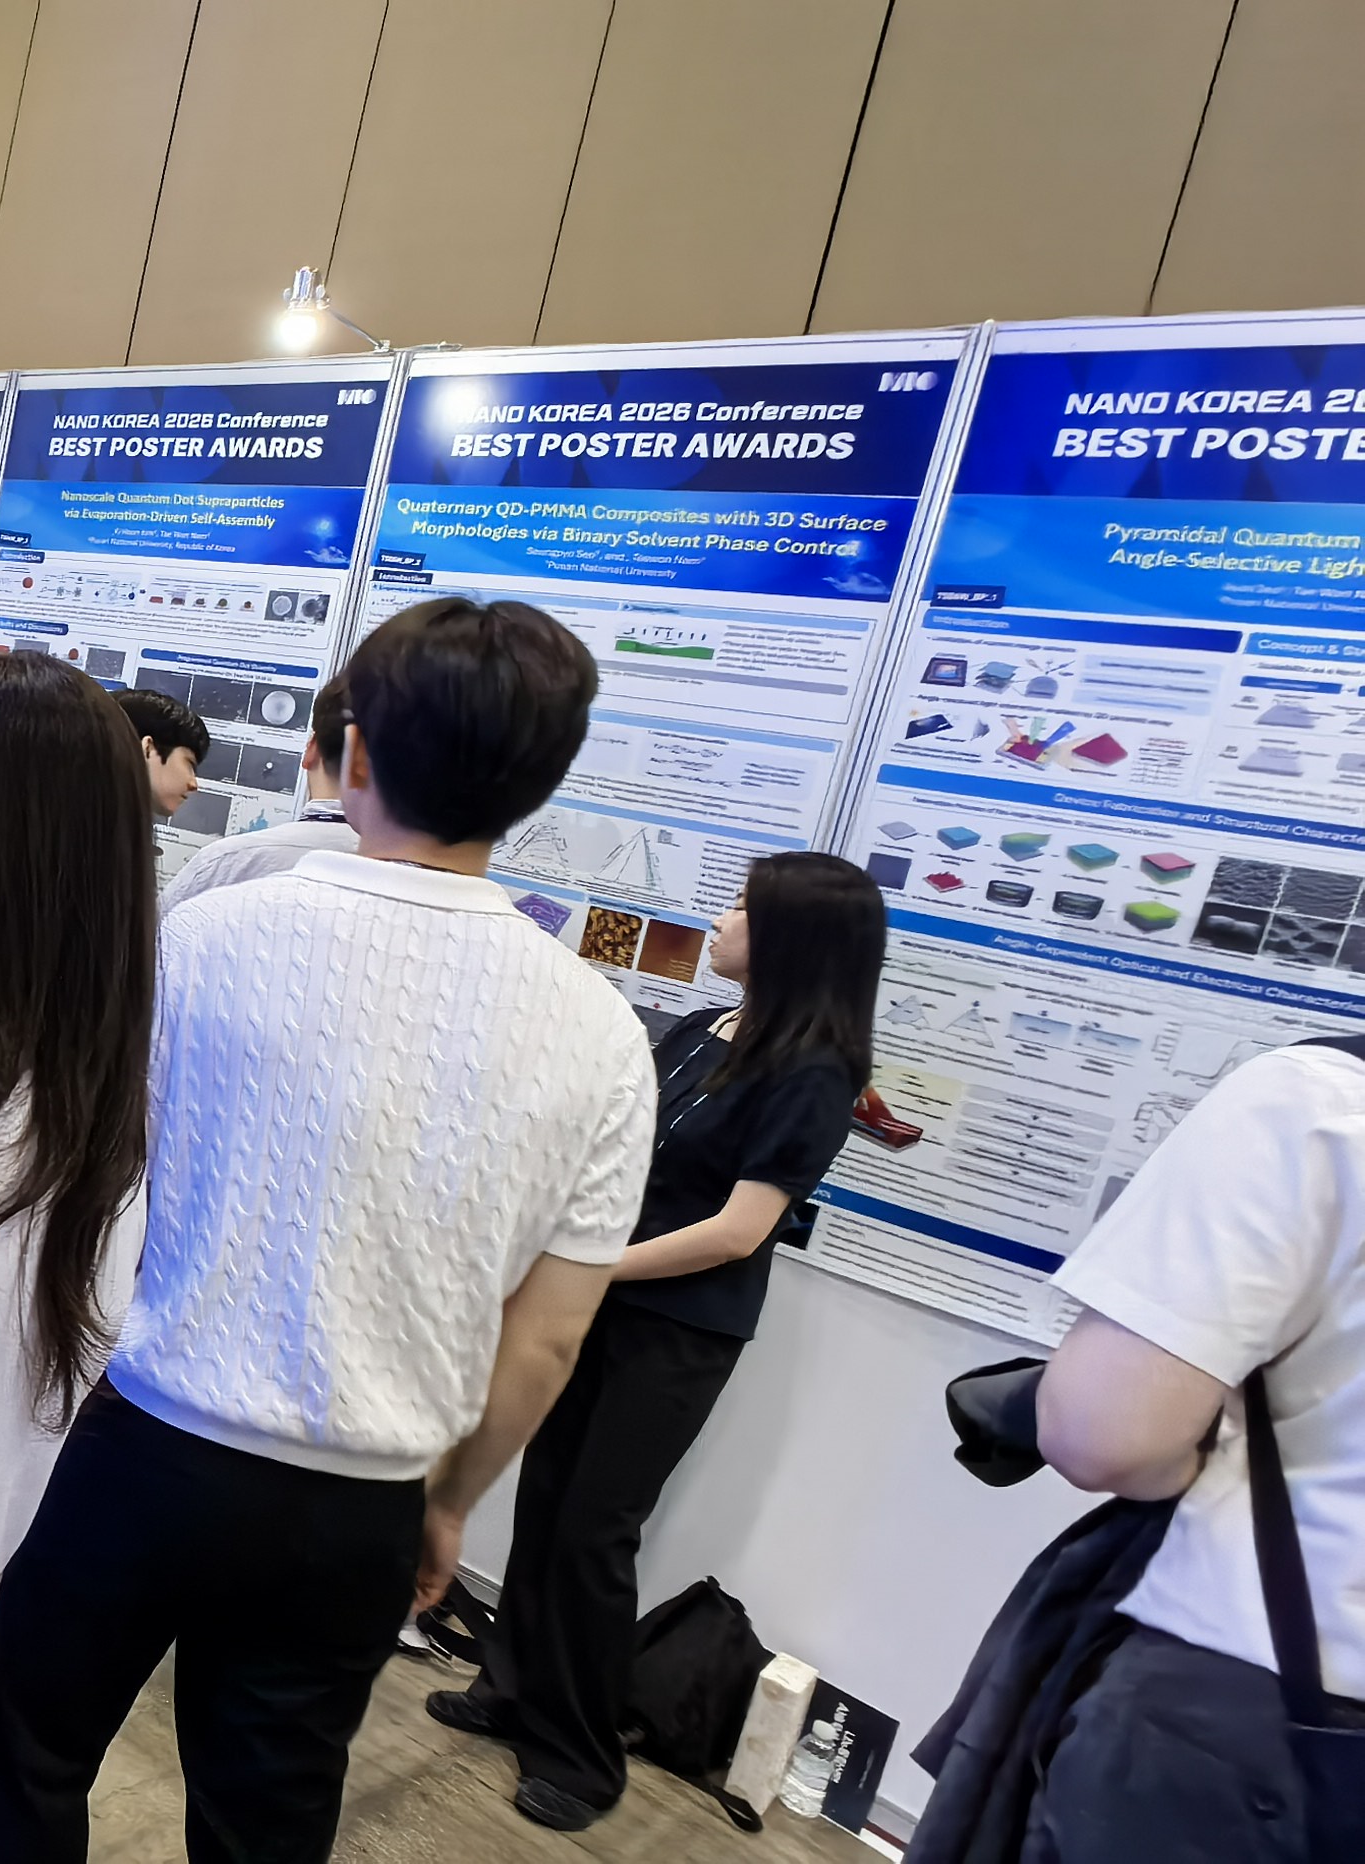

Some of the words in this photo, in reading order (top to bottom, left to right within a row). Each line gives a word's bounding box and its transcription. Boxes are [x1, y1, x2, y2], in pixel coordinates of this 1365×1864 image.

[527, 402, 612, 424] KOREA
[618, 402, 691, 423] 2026
[695, 400, 864, 423] Conference
[1065, 392, 1170, 415] NANO
[1175, 390, 1312, 415] KOREA
[53, 414, 99, 429] NANO
[102, 414, 161, 429] KOREA
[164, 414, 214, 429] 2026
[217, 412, 329, 429] Conference
[48, 437, 106, 457] BEST
[109, 437, 204, 457] POSTER
[208, 436, 324, 459] AWARDS
[450, 433, 534, 458] BEST
[538, 433, 674, 459] POSTER
[681, 431, 855, 461] AWARDS
[1052, 427, 1187, 458] BEST
[61, 490, 115, 504] Nanoscale
[118, 491, 171, 507] Quantum
[173, 493, 195, 506] Dot
[197, 493, 285, 510] Supraparticles
[64, 509, 80, 519] via
[82, 509, 188, 526] Evaporation-Driven
[190, 512, 276, 530] Self-Assembly
[397, 497, 491, 521] Quaternary
[494, 500, 587, 520] QD-PMMA
[592, 503, 711, 527] Composites
[715, 507, 760, 527] with
[764, 508, 795, 528] 3D
[799, 511, 888, 533] Surface
[411, 518, 528, 543] Morphologies
[532, 525, 558, 541] via
[563, 526, 621, 549] Binary
[625, 529, 701, 550] Solvent
[705, 532, 770, 553] Phase
[773, 535, 859, 557] Control
[1103, 523, 1225, 545] Pyramidal
[1234, 527, 1360, 550] Quantum
[1109, 548, 1301, 575] Angle-Selective
